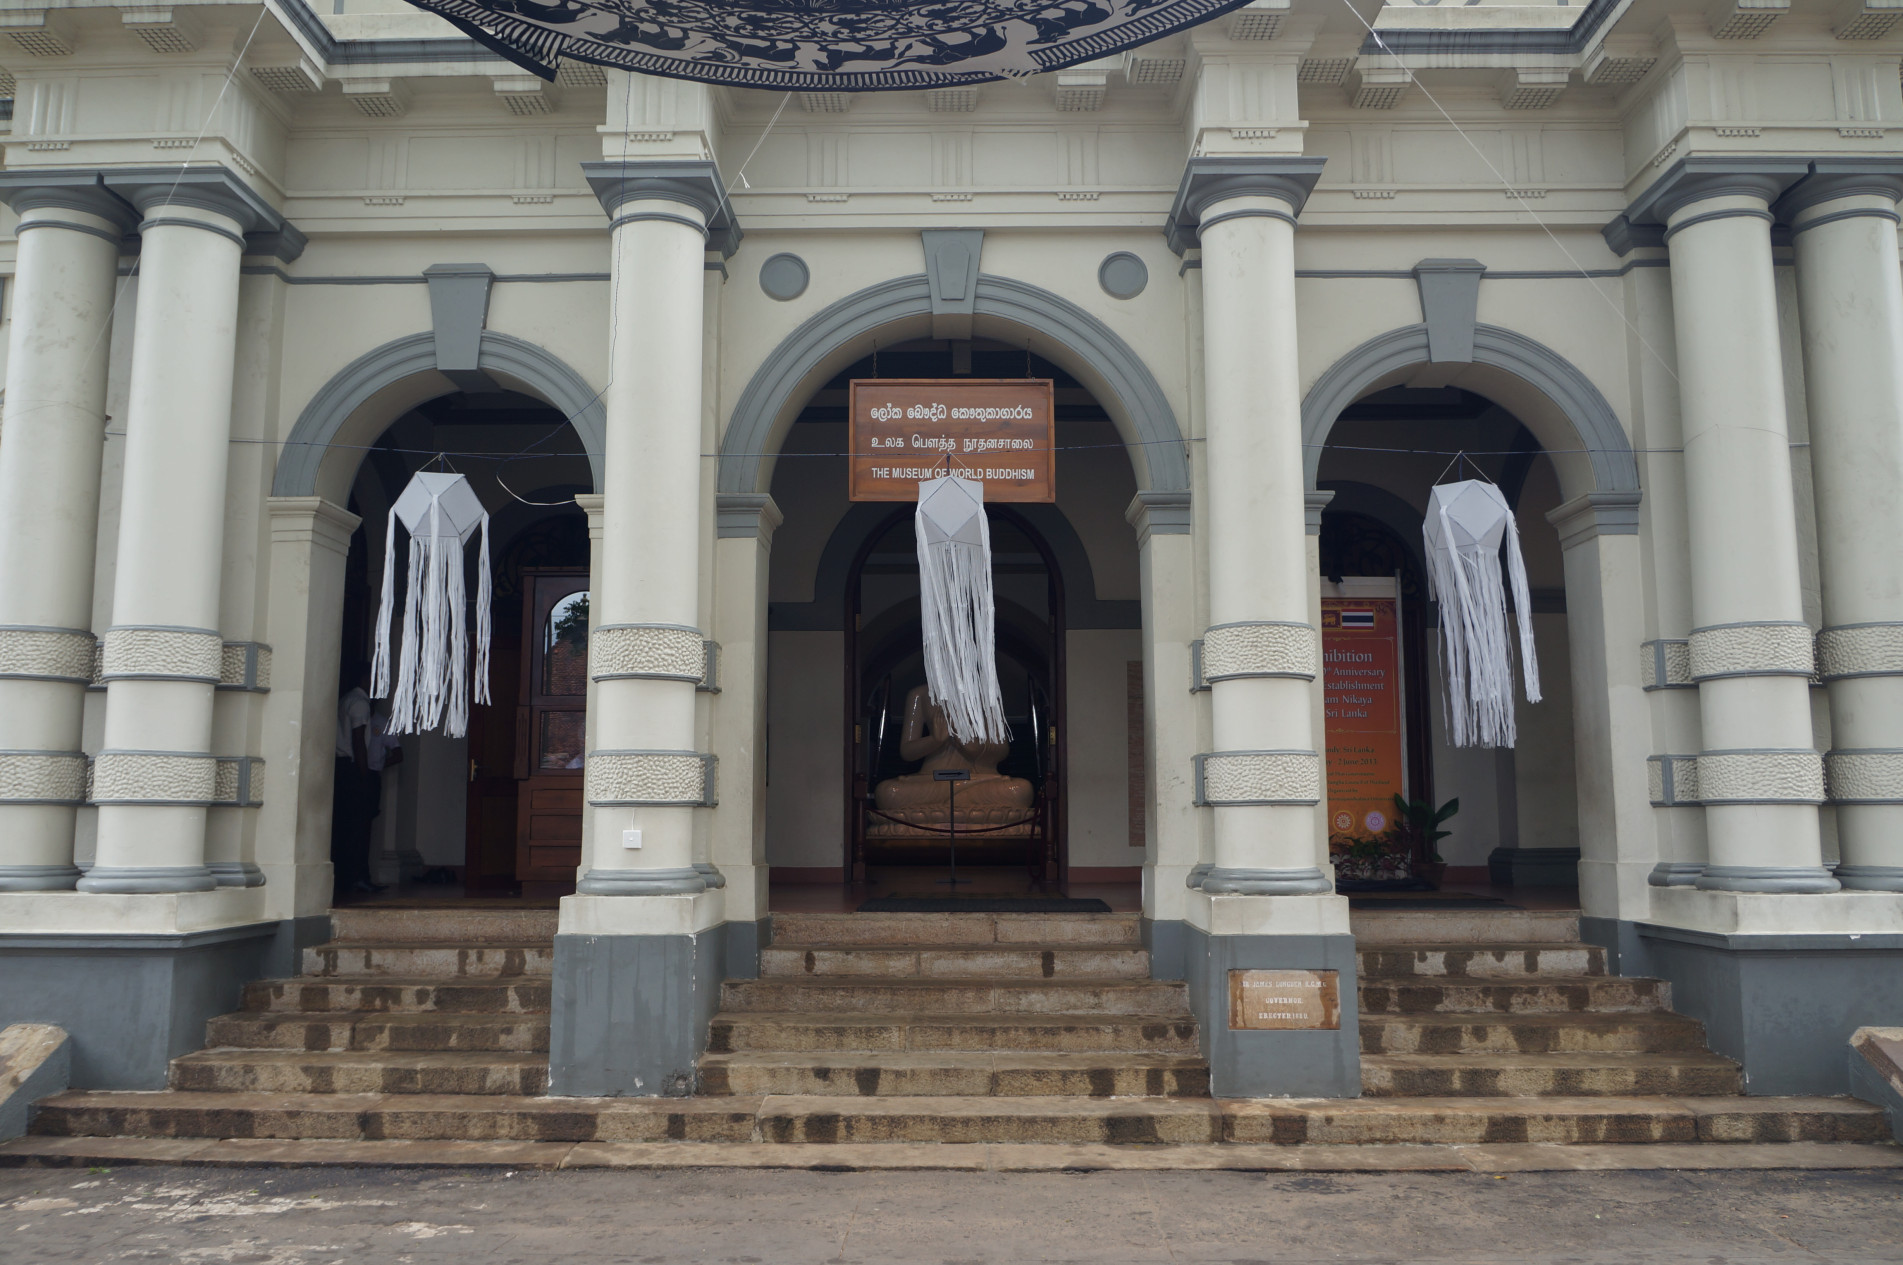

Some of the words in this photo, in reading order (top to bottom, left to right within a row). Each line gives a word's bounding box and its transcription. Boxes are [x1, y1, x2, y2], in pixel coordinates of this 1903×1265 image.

[870, 403, 902, 422] ලෝක
[871, 437, 904, 448] உலக
[911, 433, 956, 452] பௌத்த
[963, 438, 1033, 452] நூதனசாலை
[872, 467, 890, 478] THE
[892, 467, 932, 479] MUSEUM
[934, 468, 947, 479] OF
[949, 468, 983, 479] WORLD
[986, 468, 1035, 480] BUDDHISM
[1333, 667, 1385, 679] Anniversary
[1342, 694, 1373, 707] Nikaya
[1326, 708, 1338, 718] Sri
[1342, 708, 1368, 718] Lanka
[1353, 745, 1375, 753] Lanka
